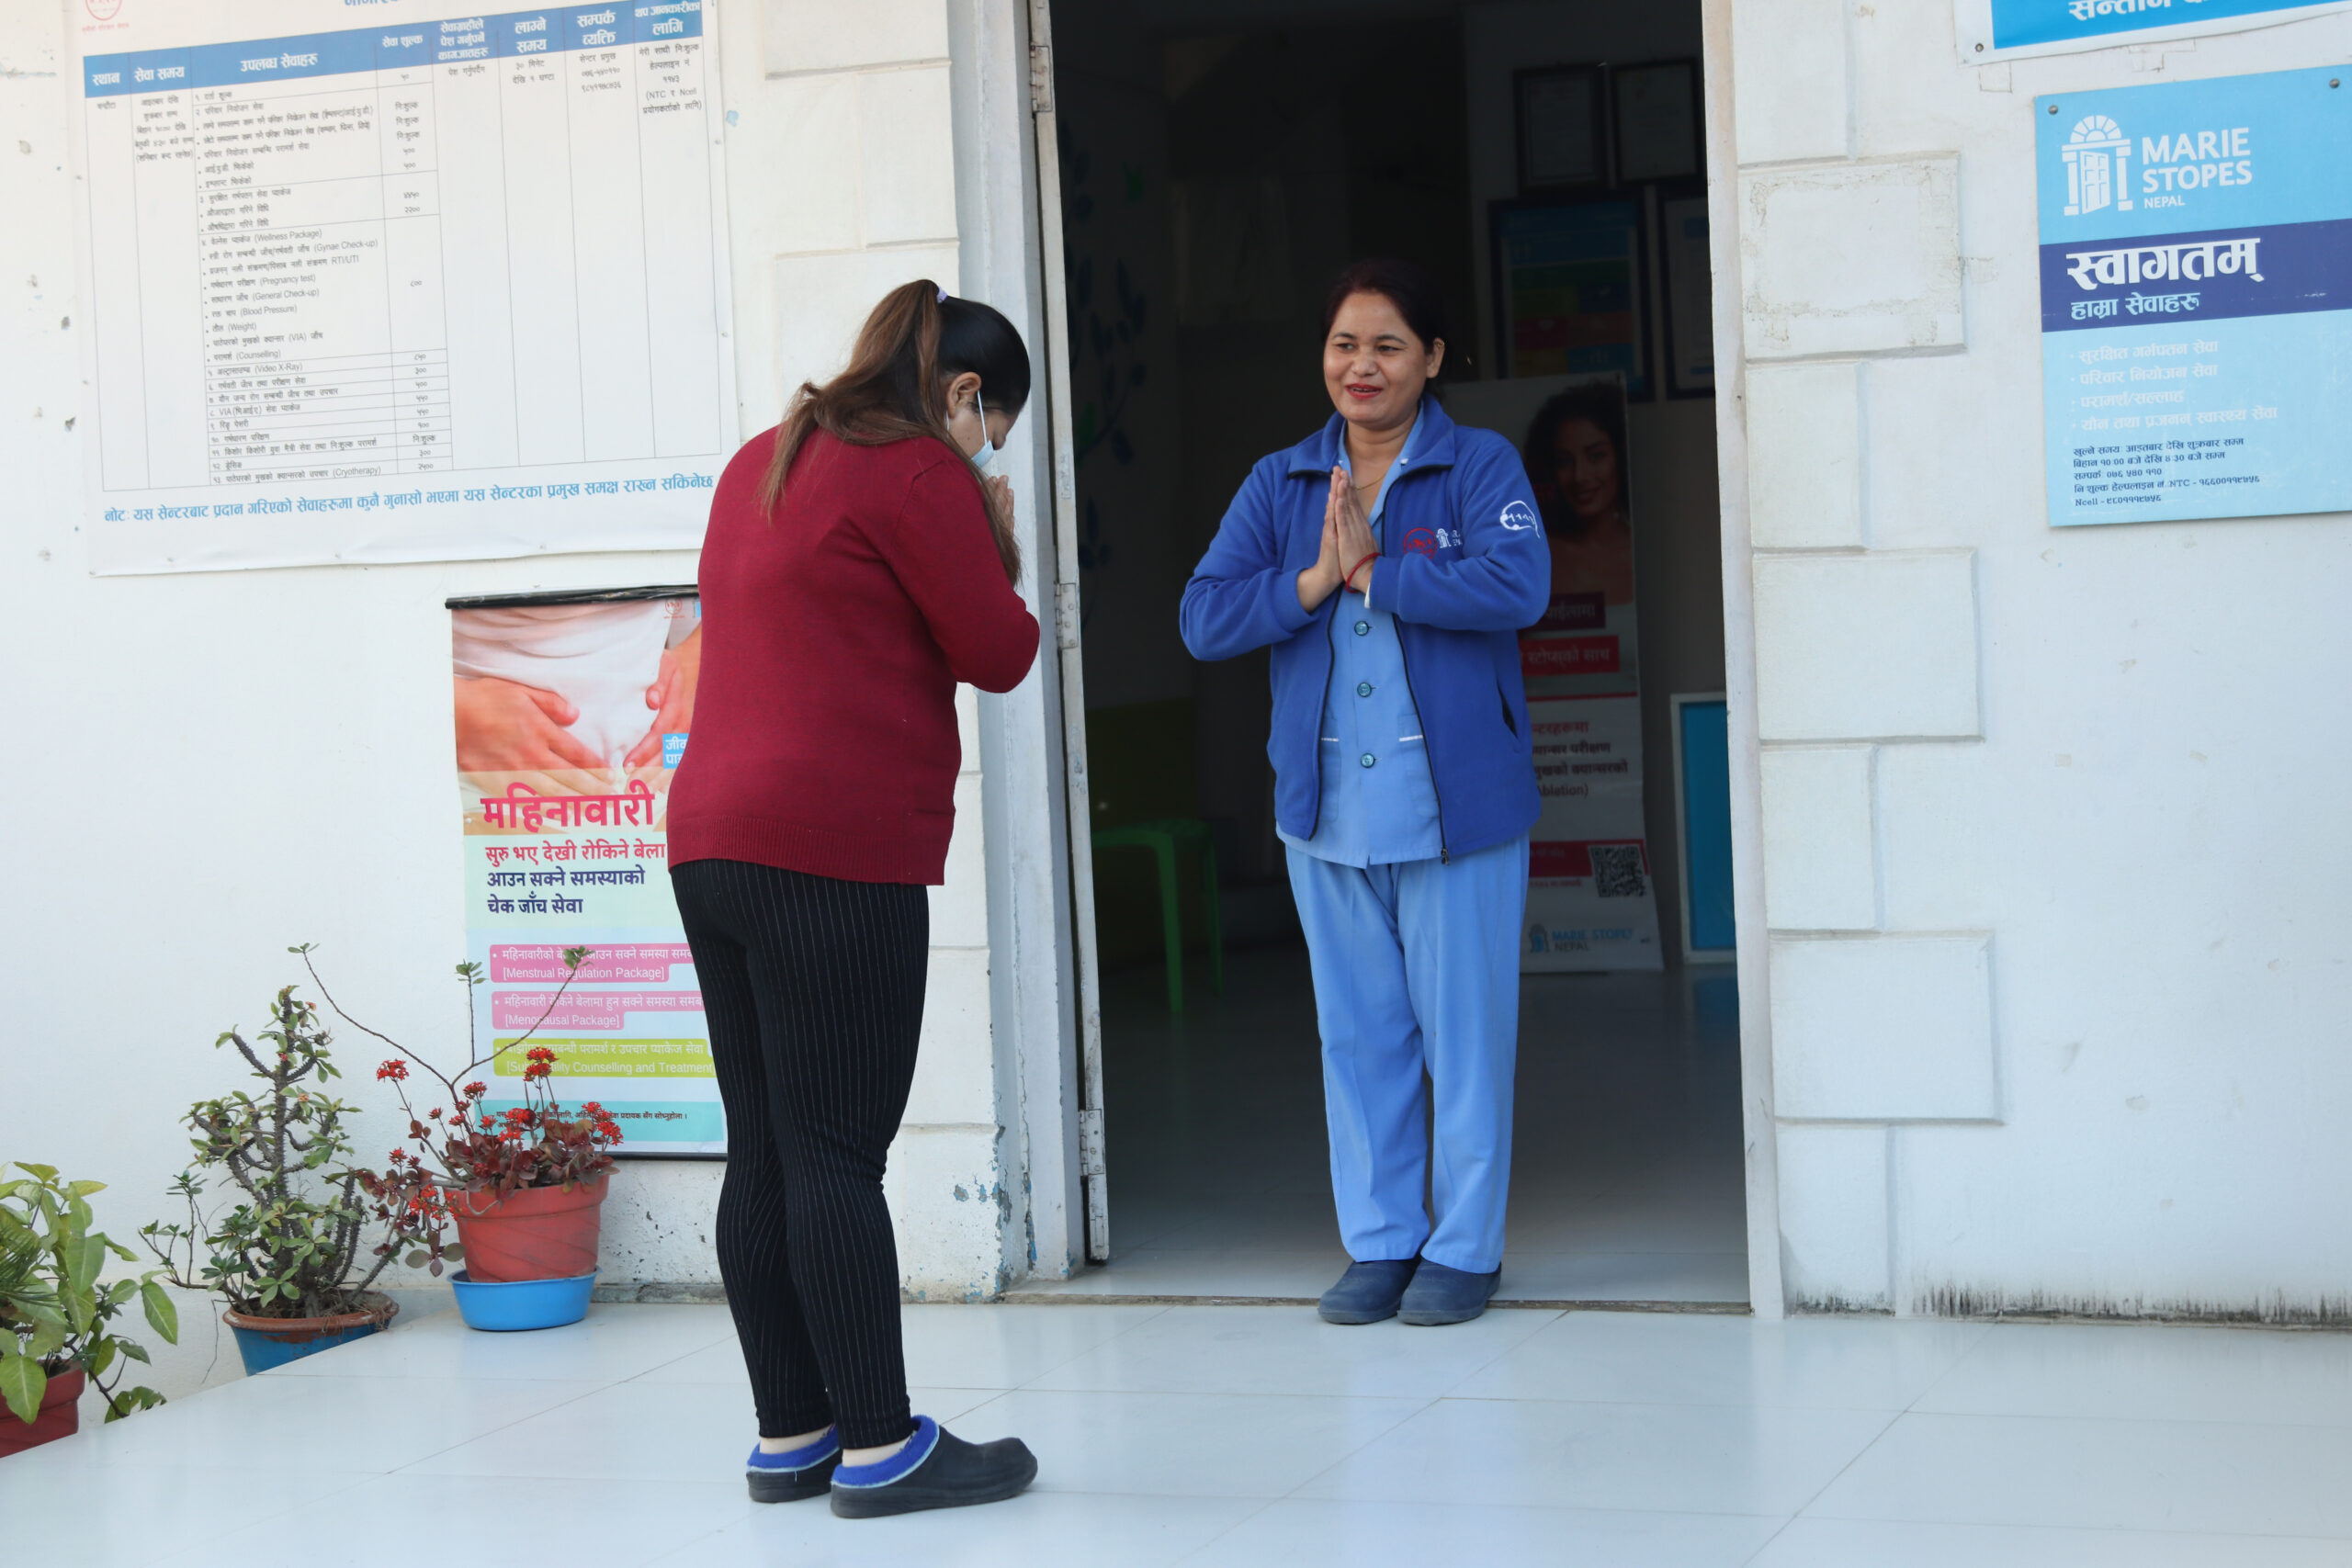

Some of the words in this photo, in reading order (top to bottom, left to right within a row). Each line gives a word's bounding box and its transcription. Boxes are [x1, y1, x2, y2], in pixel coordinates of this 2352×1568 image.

[514, 16, 547, 34] लाग्ने
[577, 9, 616, 28] सम्पर्क
[652, 18, 684, 35] लागि
[382, 37, 399, 48] सेवा
[401, 34, 423, 48] शुल्क
[582, 29, 616, 46] व्यक्ति
[516, 39, 547, 53] समय
[241, 56, 277, 72] उपलब्ध
[93, 72, 120, 86] स्थान
[134, 67, 154, 82] सेवा
[157, 66, 185, 81] समय
[2142, 127, 2251, 165] MARIE
[2143, 160, 2252, 195] STOPES
[2143, 195, 2186, 209] NEPAL
[254, 232, 288, 244] (Wellness
[289, 228, 322, 240] Package)
[341, 238, 378, 250] Check-up)
[2066, 237, 2265, 291] स्वागतम्
[260, 276, 299, 288] (Pregnancy
[253, 291, 282, 302] (General
[284, 288, 320, 299] Check-up)
[241, 307, 263, 318] (Blood
[2071, 299, 2119, 321] हाम्रा
[2078, 344, 2129, 366] सुरक्षित
[2132, 342, 2188, 358] गर्भपतन
[2192, 338, 2220, 355] सेवा
[2079, 369, 2126, 386] परिवार
[2130, 366, 2188, 383] नियोजन
[2191, 362, 2219, 378] सेवा
[2080, 416, 2109, 431] यौन
[2113, 415, 2141, 430] तथा
[2251, 404, 2278, 420] सेवा
[2223, 437, 2245, 447] सम्म
[2169, 478, 2190, 489] NTC
[133, 508, 153, 521] यस
[157, 504, 209, 520] सेन्टरबाट
[213, 503, 243, 518] प्रदान
[247, 497, 292, 515] गरिएको
[356, 491, 379, 511] कुनै
[384, 489, 422, 510] गुनासो
[426, 490, 459, 504] भएमा
[464, 490, 485, 502] यस
[490, 484, 542, 500] सेन्टरका
[548, 483, 580, 500] प्रमुख
[584, 482, 619, 494] समक्ष
[623, 479, 656, 492] राख्न
[661, 473, 714, 490] सकिनेछ
[2075, 497, 2098, 508] Ncell
[480, 779, 655, 833] महिनावारी
[485, 846, 509, 867] सुरु
[513, 845, 538, 865] भए
[542, 840, 577, 862] देखी
[581, 838, 630, 860] रोकिने
[633, 838, 666, 859] बेला
[487, 872, 526, 887] आउन
[530, 865, 566, 886] सक्ने
[570, 864, 646, 886] समस्याको
[487, 894, 514, 913] चेक
[518, 890, 548, 914] जाँच
[551, 893, 583, 913] सेवा
[503, 947, 554, 961] महिनावारीको
[615, 947, 638, 960] सक्ने
[639, 949, 669, 960] समस्या
[503, 967, 555, 980] [Menstrual
[558, 966, 613, 981] Regulation
[616, 966, 665, 981] Package]
[504, 994, 547, 1008] महिनावारी
[622, 994, 644, 1007] सक्ने
[646, 996, 676, 1008] समस्या
[504, 1014, 569, 1028] [Menopausal
[571, 1013, 620, 1029] Package]
[685, 1042, 704, 1054] सेवा
[572, 1061, 633, 1075] Counselling
[635, 1062, 655, 1074] and
[658, 1061, 715, 1075] Treatment]
